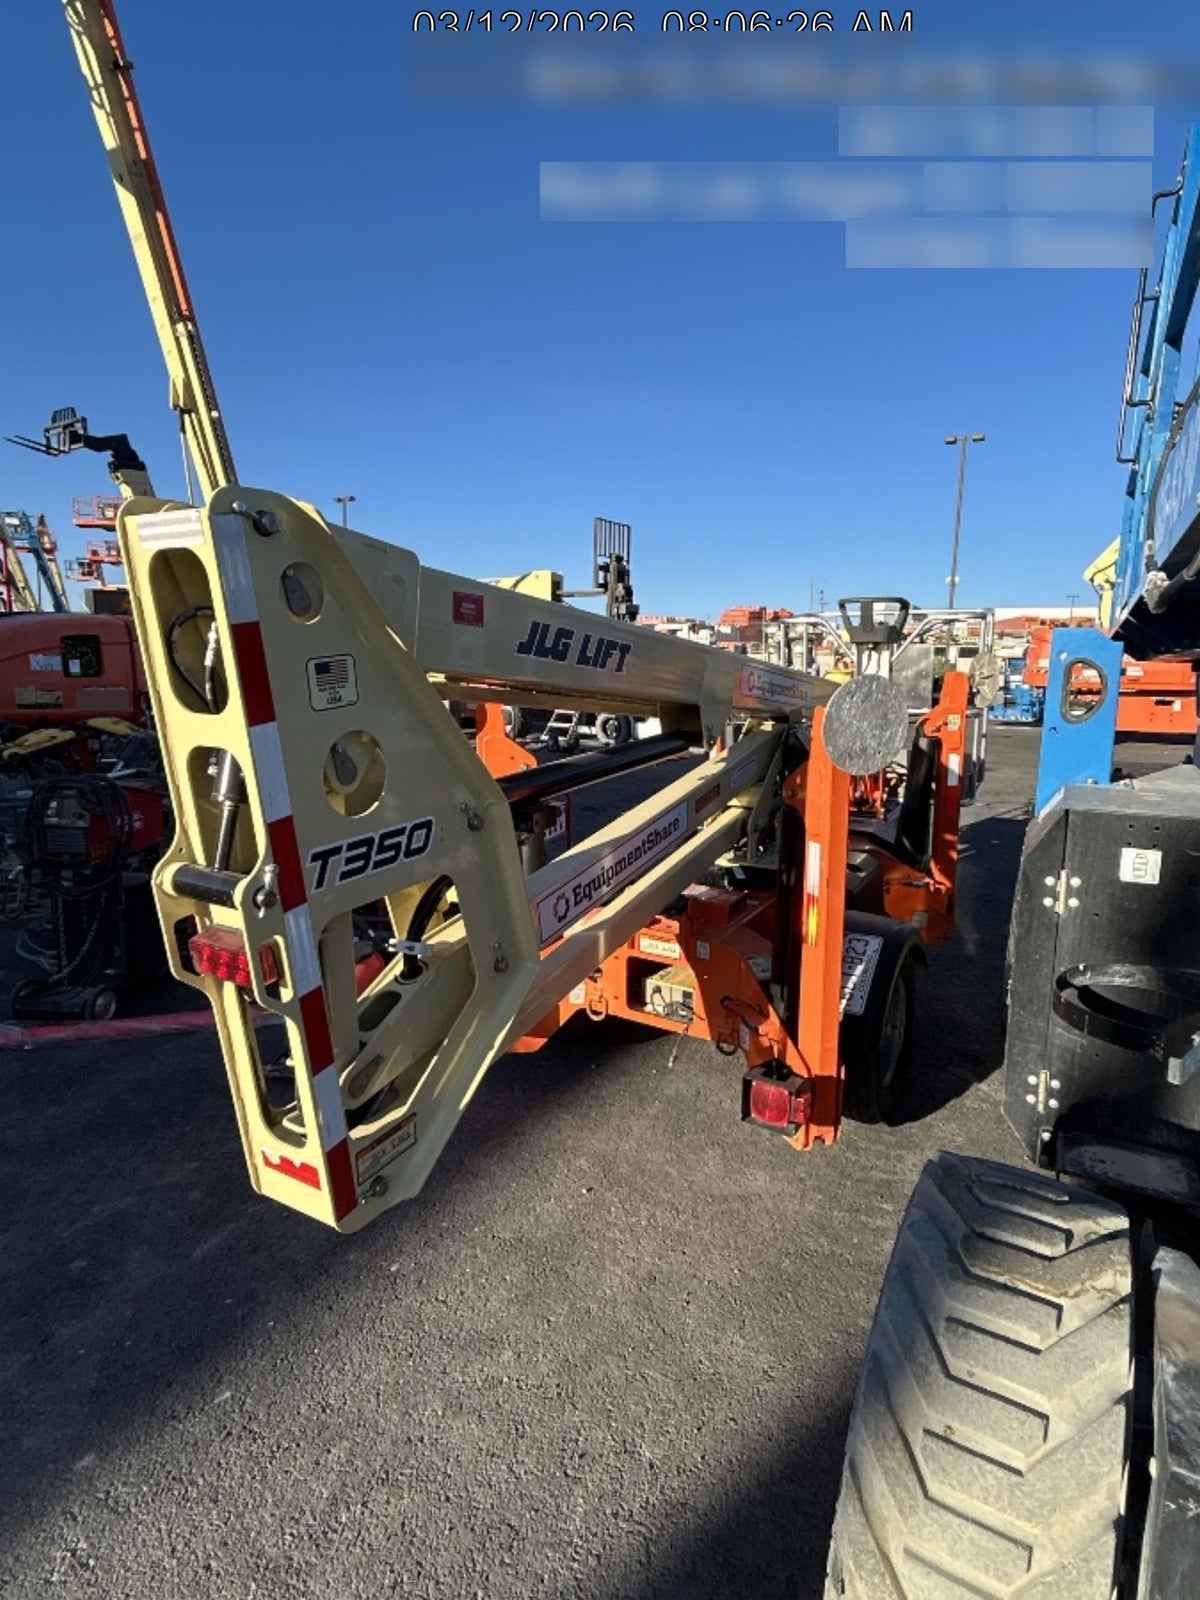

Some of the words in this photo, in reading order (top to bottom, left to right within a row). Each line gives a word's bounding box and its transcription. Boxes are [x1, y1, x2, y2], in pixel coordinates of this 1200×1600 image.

[514, 620, 575, 662] JLG
[576, 633, 632, 673] LIFT
[308, 818, 434, 892] T350
[571, 816, 680, 907] EquipmentShare
